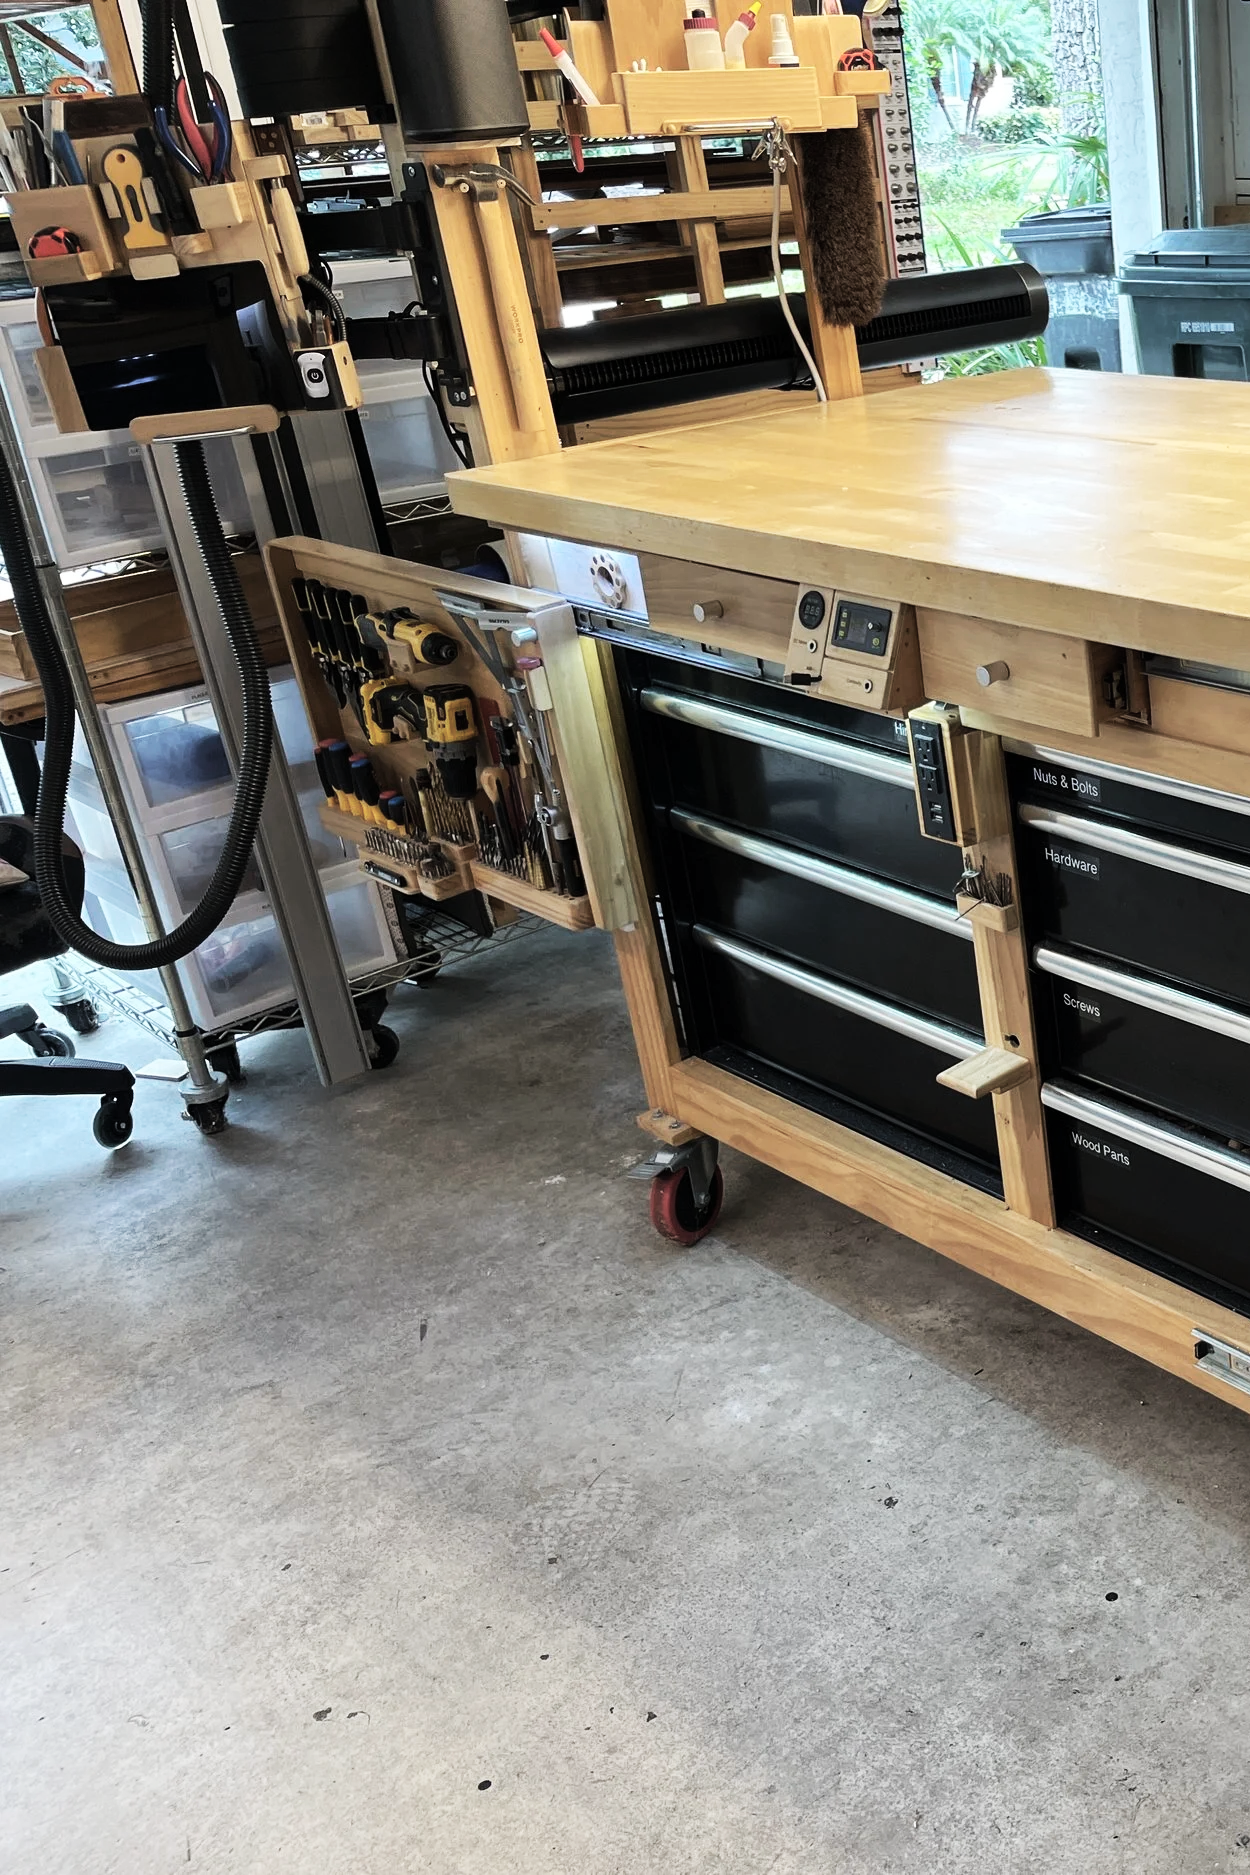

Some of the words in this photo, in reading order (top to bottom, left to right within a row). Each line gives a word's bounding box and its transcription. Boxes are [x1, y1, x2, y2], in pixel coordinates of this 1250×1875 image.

[1033, 767, 1058, 786] Nuts
[1060, 774, 1069, 789] &
[1071, 777, 1099, 797] Bolts
[1044, 847, 1098, 875] Hardware
[1063, 993, 1100, 1017] Screws
[1071, 1131, 1101, 1154] Wood
[1103, 1144, 1130, 1166] Parts
